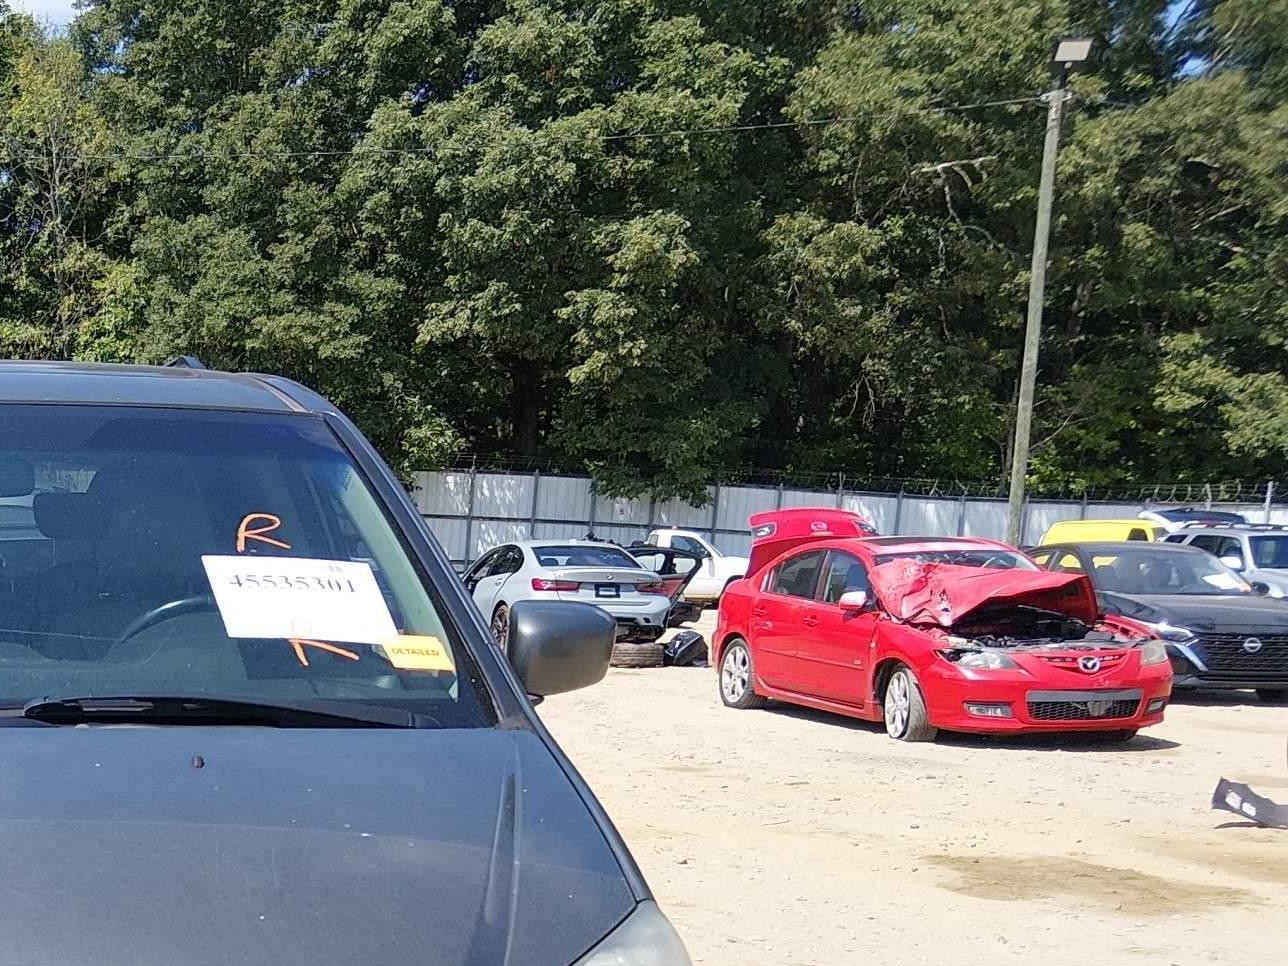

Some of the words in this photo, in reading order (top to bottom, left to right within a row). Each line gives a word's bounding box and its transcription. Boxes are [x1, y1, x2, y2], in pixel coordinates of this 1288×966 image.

[235, 512, 291, 553] R
[229, 573, 356, 594] 45535301
[392, 648, 440, 656] DETAILED
